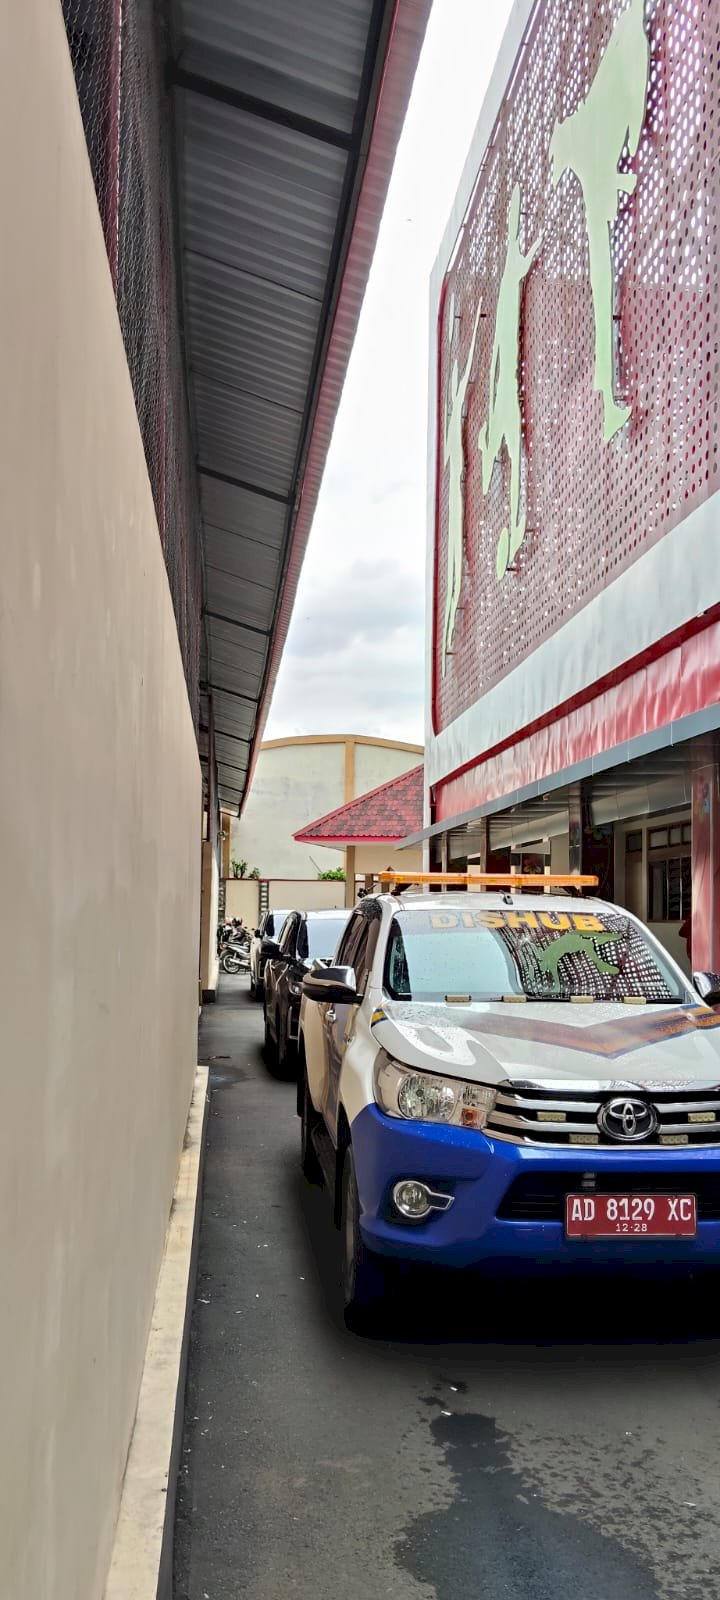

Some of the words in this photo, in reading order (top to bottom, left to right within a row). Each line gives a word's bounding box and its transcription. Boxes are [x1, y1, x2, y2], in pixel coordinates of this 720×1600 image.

[430, 910, 605, 932] DISHUB
[571, 1198, 595, 1221] AD
[606, 1198, 655, 1221] 8129
[667, 1198, 691, 1220] XC
